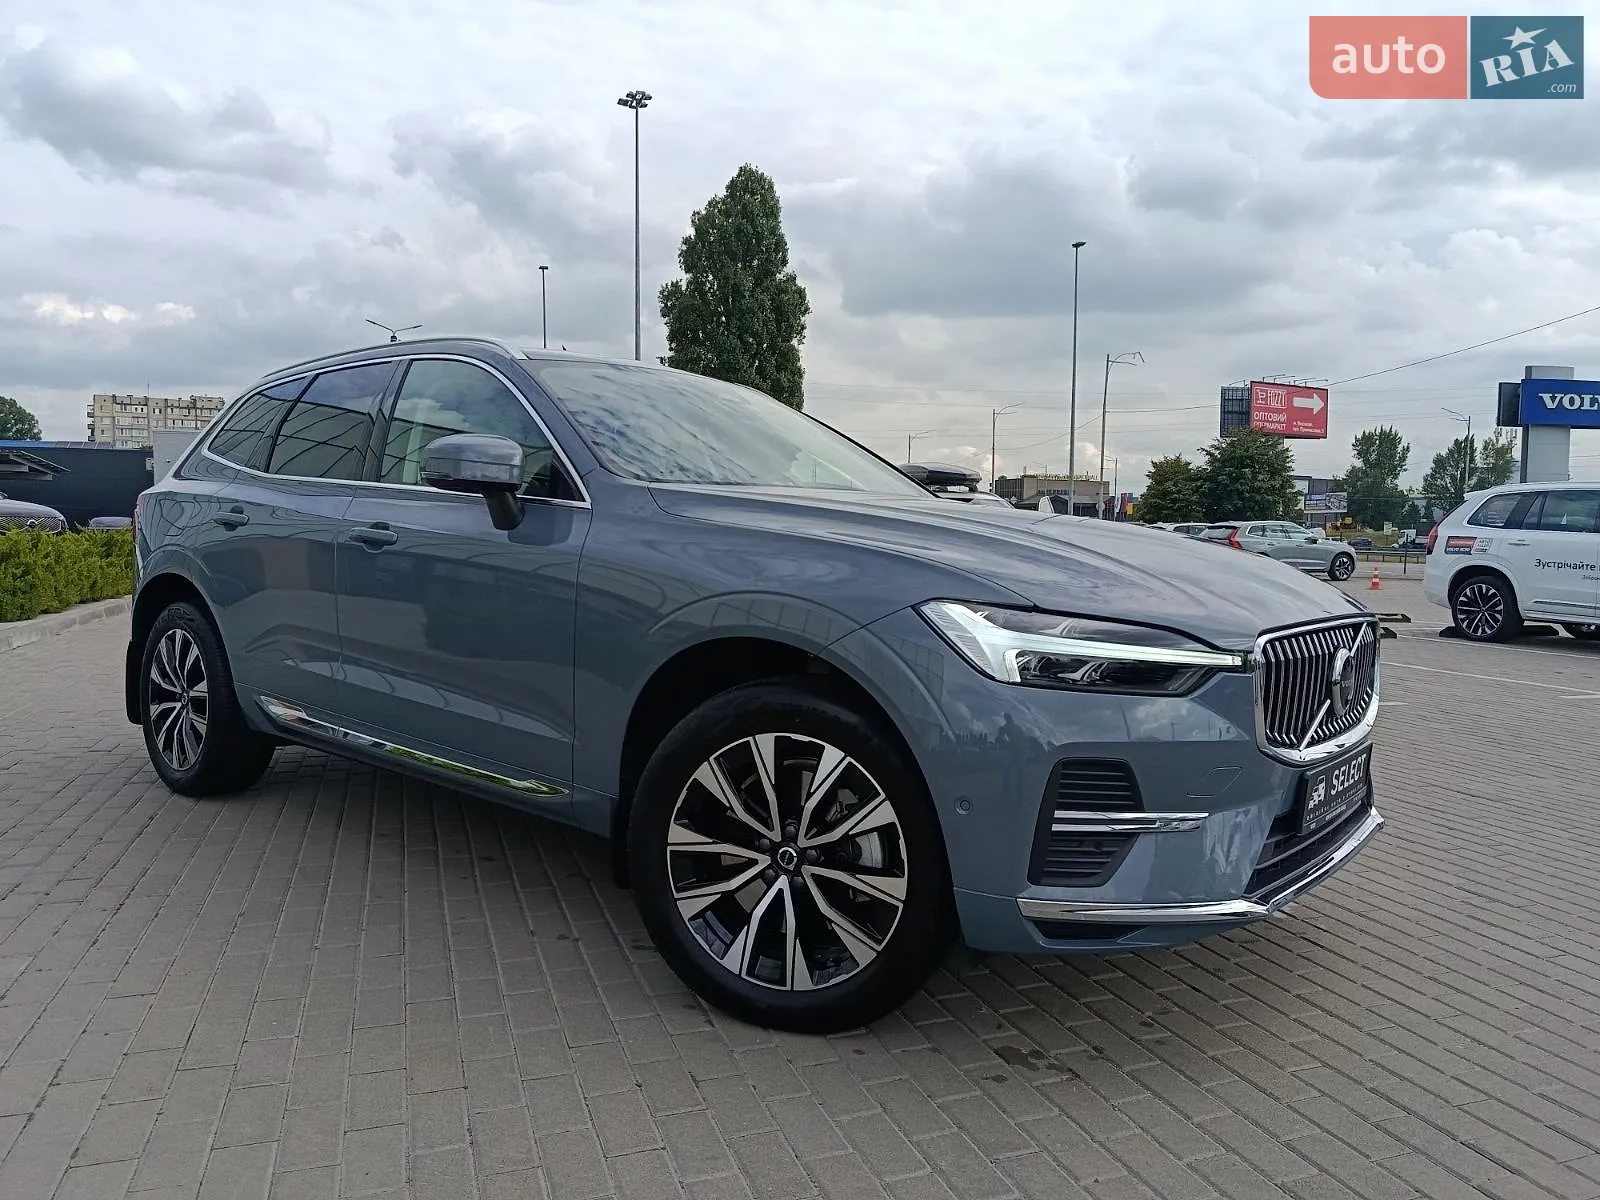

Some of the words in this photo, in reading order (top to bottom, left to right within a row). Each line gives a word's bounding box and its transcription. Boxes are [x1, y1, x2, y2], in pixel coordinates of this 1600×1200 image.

[1267, 389, 1287, 407] FOZZY
[1538, 393, 1600, 410] VOL
[1253, 411, 1287, 423] ОПТОВИЙ
[1534, 558, 1596, 571] Зустрічайте
[1330, 753, 1367, 796] SELECT
